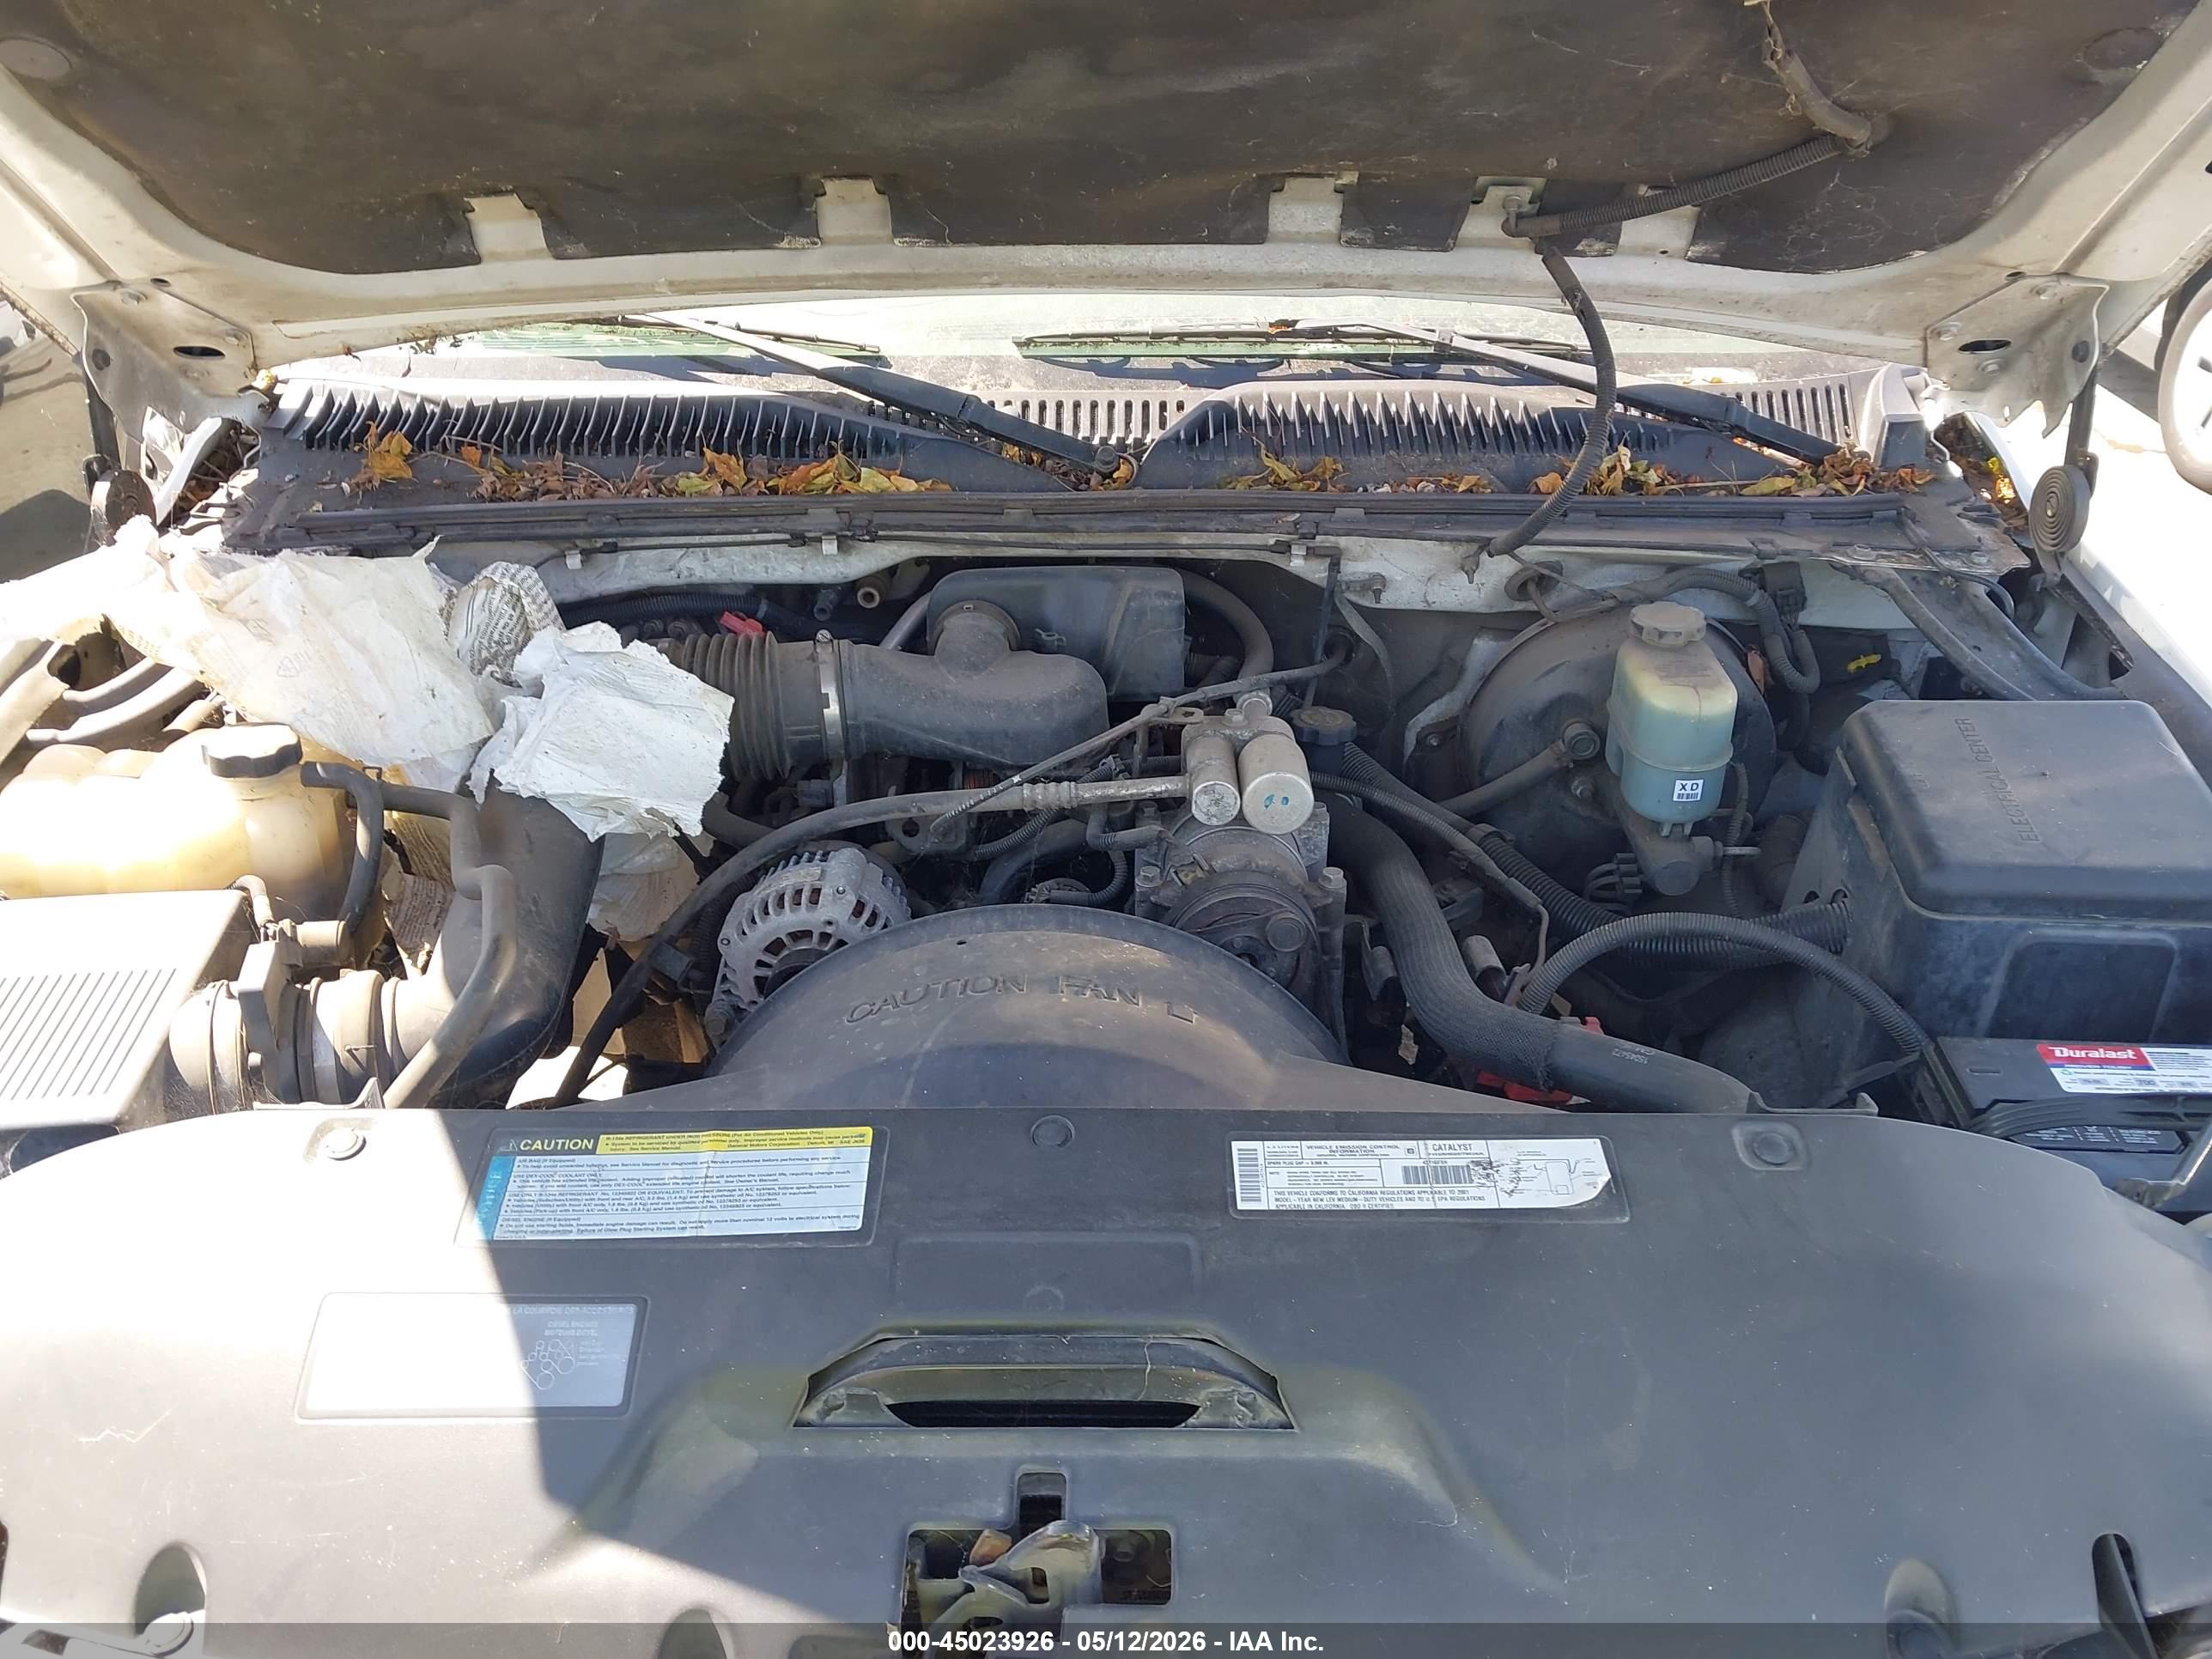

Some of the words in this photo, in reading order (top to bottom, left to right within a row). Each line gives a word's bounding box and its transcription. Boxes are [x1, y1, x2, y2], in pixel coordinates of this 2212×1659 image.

[1954, 717, 1995, 763] CENTER
[1981, 764, 2041, 843] ELECTRICAL
[845, 973, 1029, 1024] CAUTION
[1057, 974, 1141, 1007] FAN
[2048, 1046, 2137, 1060] Duralast
[520, 1138, 593, 1152] CAUTION
[1431, 1143, 1473, 1152] CATALYST
